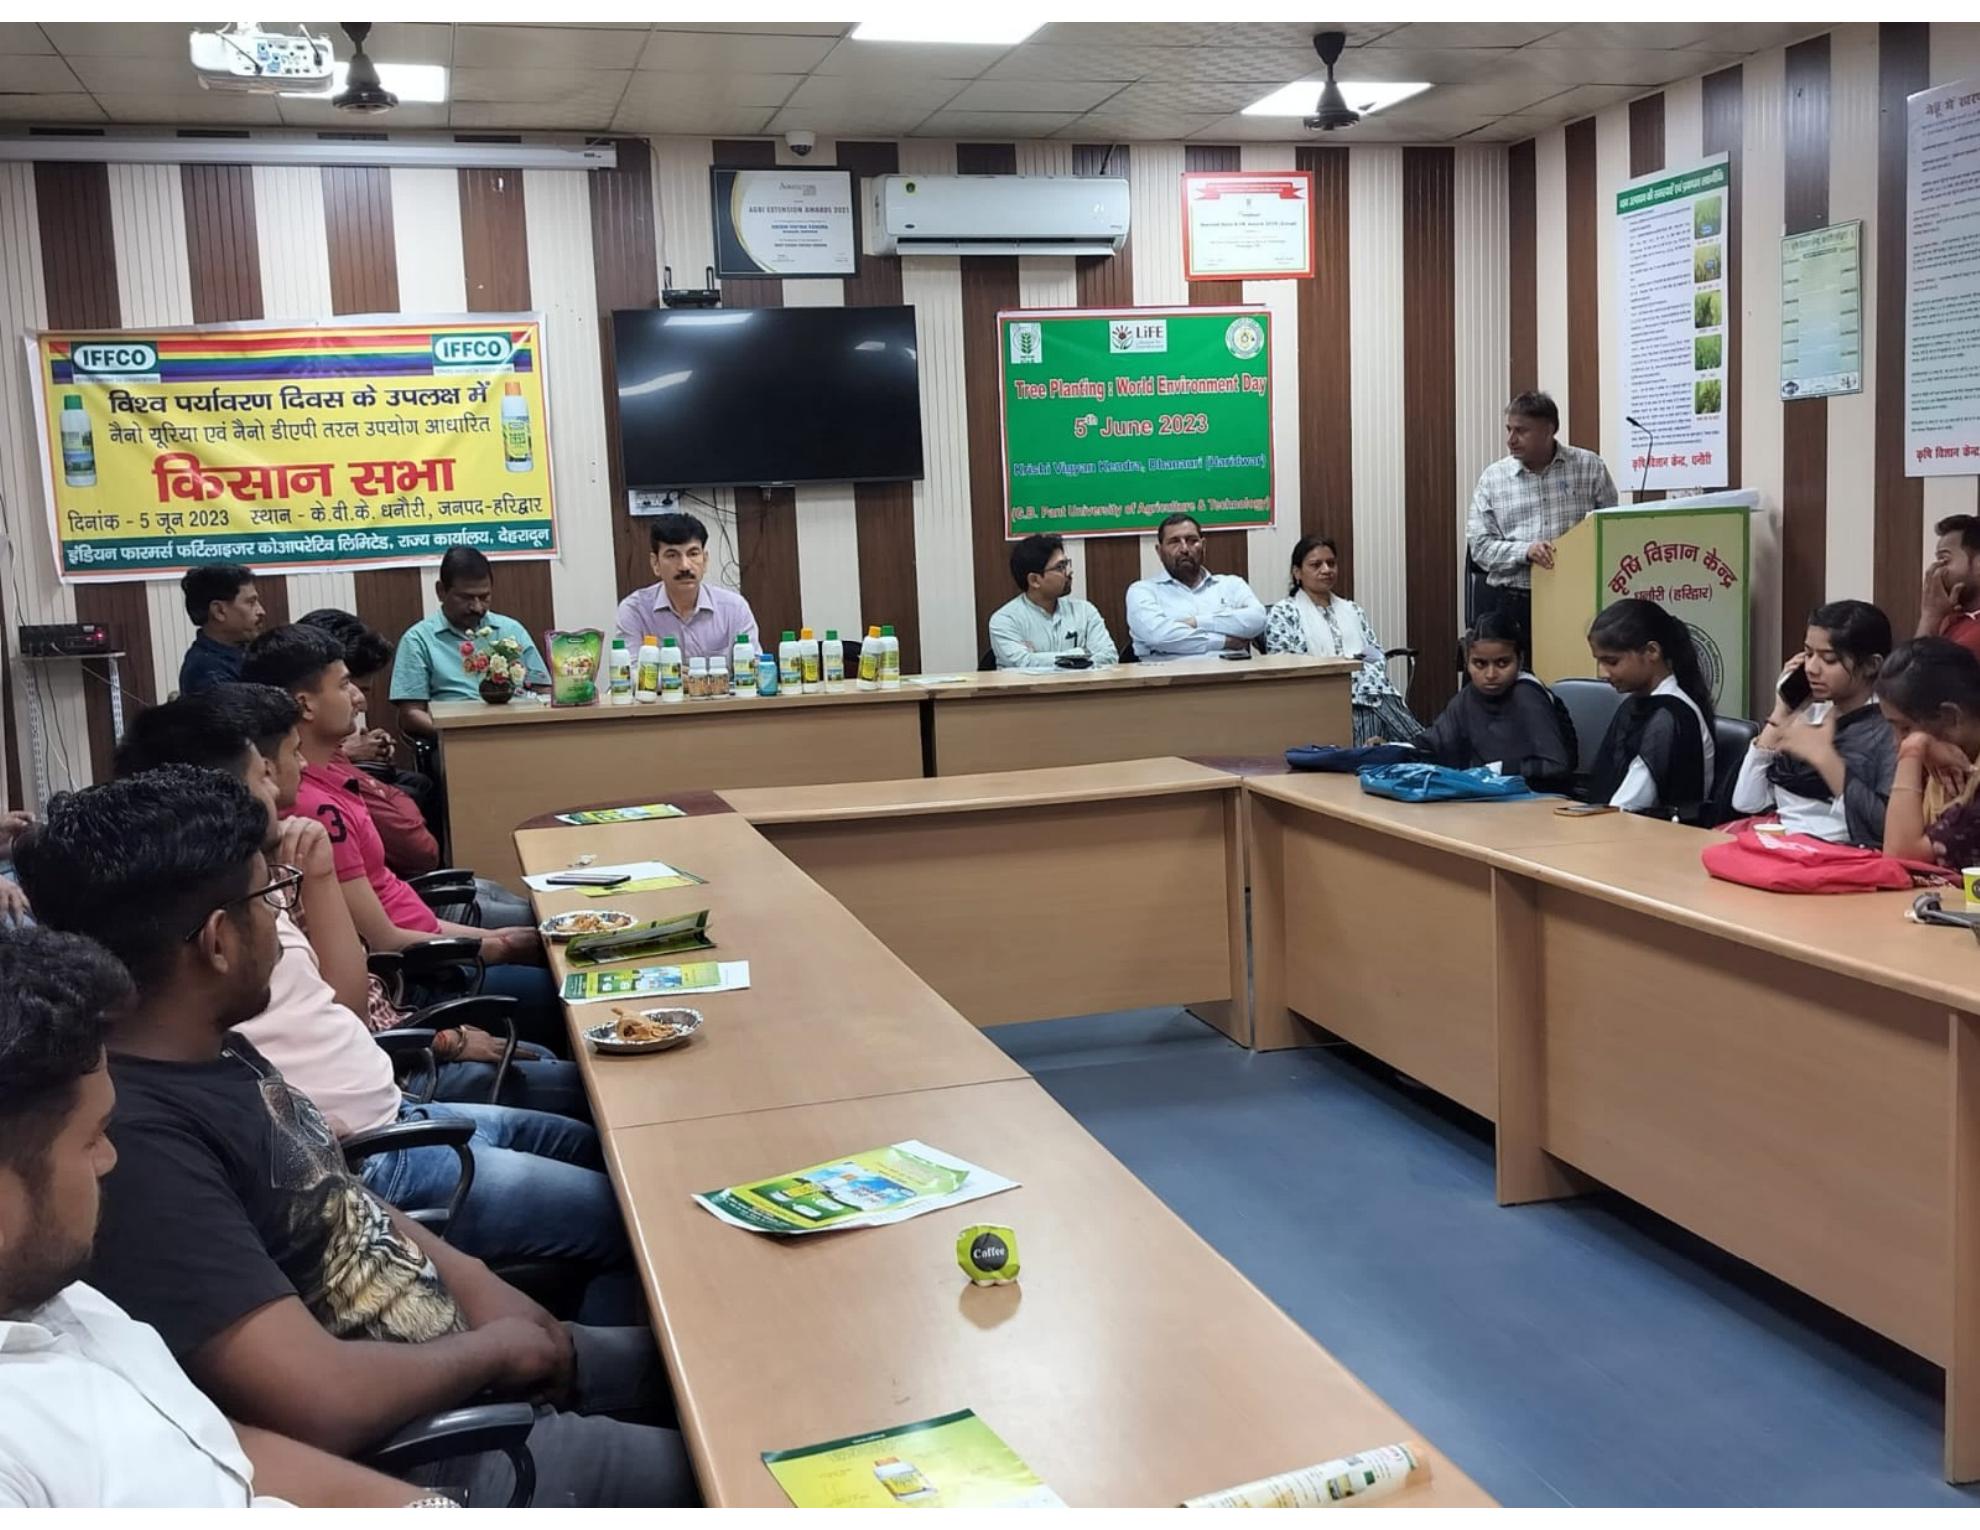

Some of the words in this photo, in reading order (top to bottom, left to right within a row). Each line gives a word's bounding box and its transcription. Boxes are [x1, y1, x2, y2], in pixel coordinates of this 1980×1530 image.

[1136, 325, 1163, 338] LiFE
[83, 350, 147, 366] IFFCO
[443, 341, 501, 357] IFFCO
[109, 389, 166, 414] विश्व
[175, 387, 272, 412] पर्यावरण
[280, 385, 344, 409] दिवस
[353, 384, 377, 407] के
[385, 388, 460, 407] उपलक्ष
[468, 381, 491, 404] में
[1015, 380, 1046, 399] Tree
[1049, 377, 1104, 401] Planting
[1116, 376, 1154, 396] World
[1158, 374, 1239, 395] Environment
[1242, 373, 1267, 397] Day
[109, 421, 142, 444] नैनो
[150, 421, 197, 448] यूरिया
[204, 421, 227, 443] एवं
[233, 419, 265, 442] नैनो
[271, 417, 318, 441] डीएपी
[323, 420, 359, 438] तरल
[365, 414, 419, 438] उपयोग
[425, 411, 491, 434] आधारित
[1100, 416, 1154, 437] June
[1159, 414, 1208, 434] 2023
[152, 451, 334, 503] किसान
[348, 458, 456, 497] सभा
[67, 509, 119, 532] दिनांक
[140, 512, 149, 529] 5
[156, 511, 184, 534] जून
[189, 510, 230, 529] 2023
[250, 507, 292, 525] स्थान
[381, 496, 433, 521] धनौरी,
[438, 494, 543, 517] जनपद-हरिद्वार
[66, 543, 116, 564] इंडियन
[121, 541, 173, 561] फारमर्स
[258, 535, 334, 554] कोआपरेटिव
[338, 533, 393, 552] लिमिटेड,
[398, 534, 430, 548] राज्य
[498, 527, 549, 553] देहरादून
[1608, 554, 1642, 596] कृषि
[1644, 541, 1700, 566] विज्ञान
[317, 804, 347, 843] 3
[972, 1246, 1005, 1260] Coffee
